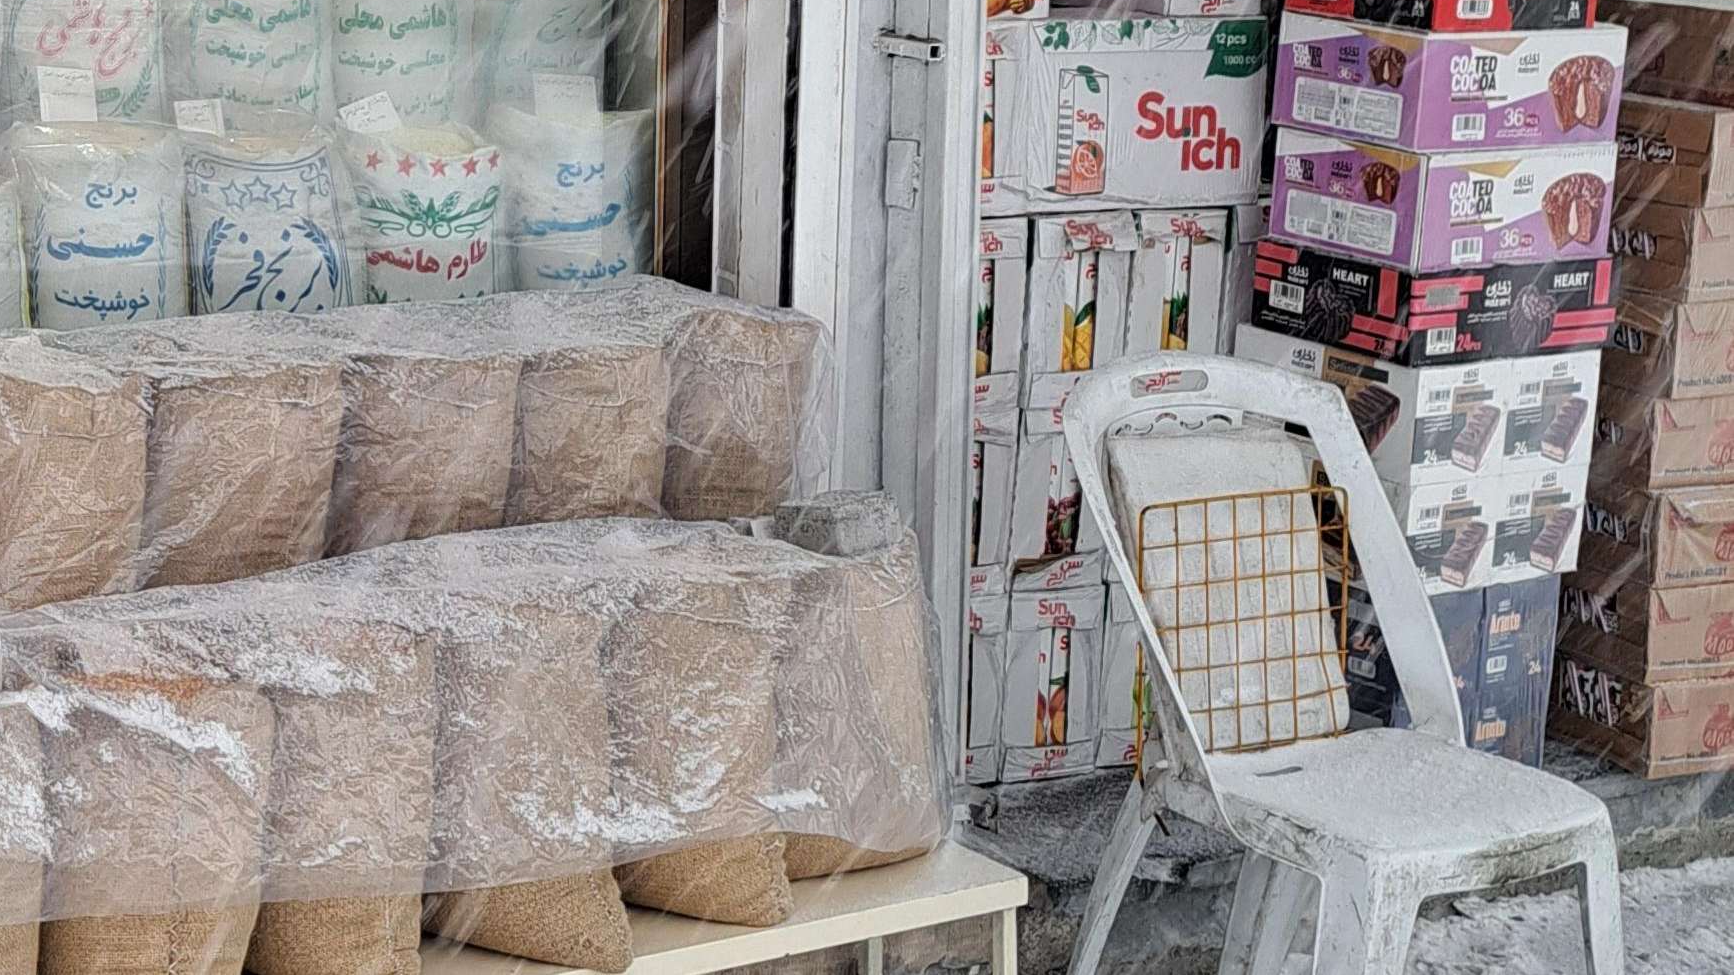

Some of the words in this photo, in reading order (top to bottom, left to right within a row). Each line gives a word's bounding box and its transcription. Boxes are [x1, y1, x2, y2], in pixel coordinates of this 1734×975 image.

[1450, 54, 1499, 75] COATED
[1451, 73, 1497, 93] COCOA
[1076, 108, 1099, 124] Sun
[1136, 91, 1217, 140] Sun
[1503, 107, 1525, 127] 36
[1181, 126, 1242, 172] ich
[555, 160, 606, 188] برنج
[84, 181, 138, 209] برنج
[1449, 178, 1495, 201] COATED
[1450, 198, 1494, 217] COCOA
[46, 227, 155, 261] حسنی
[1499, 228, 1520, 249] 36
[1332, 266, 1370, 287] HEART
[1553, 271, 1590, 289] HEART
[1038, 598, 1068, 617] Sun
